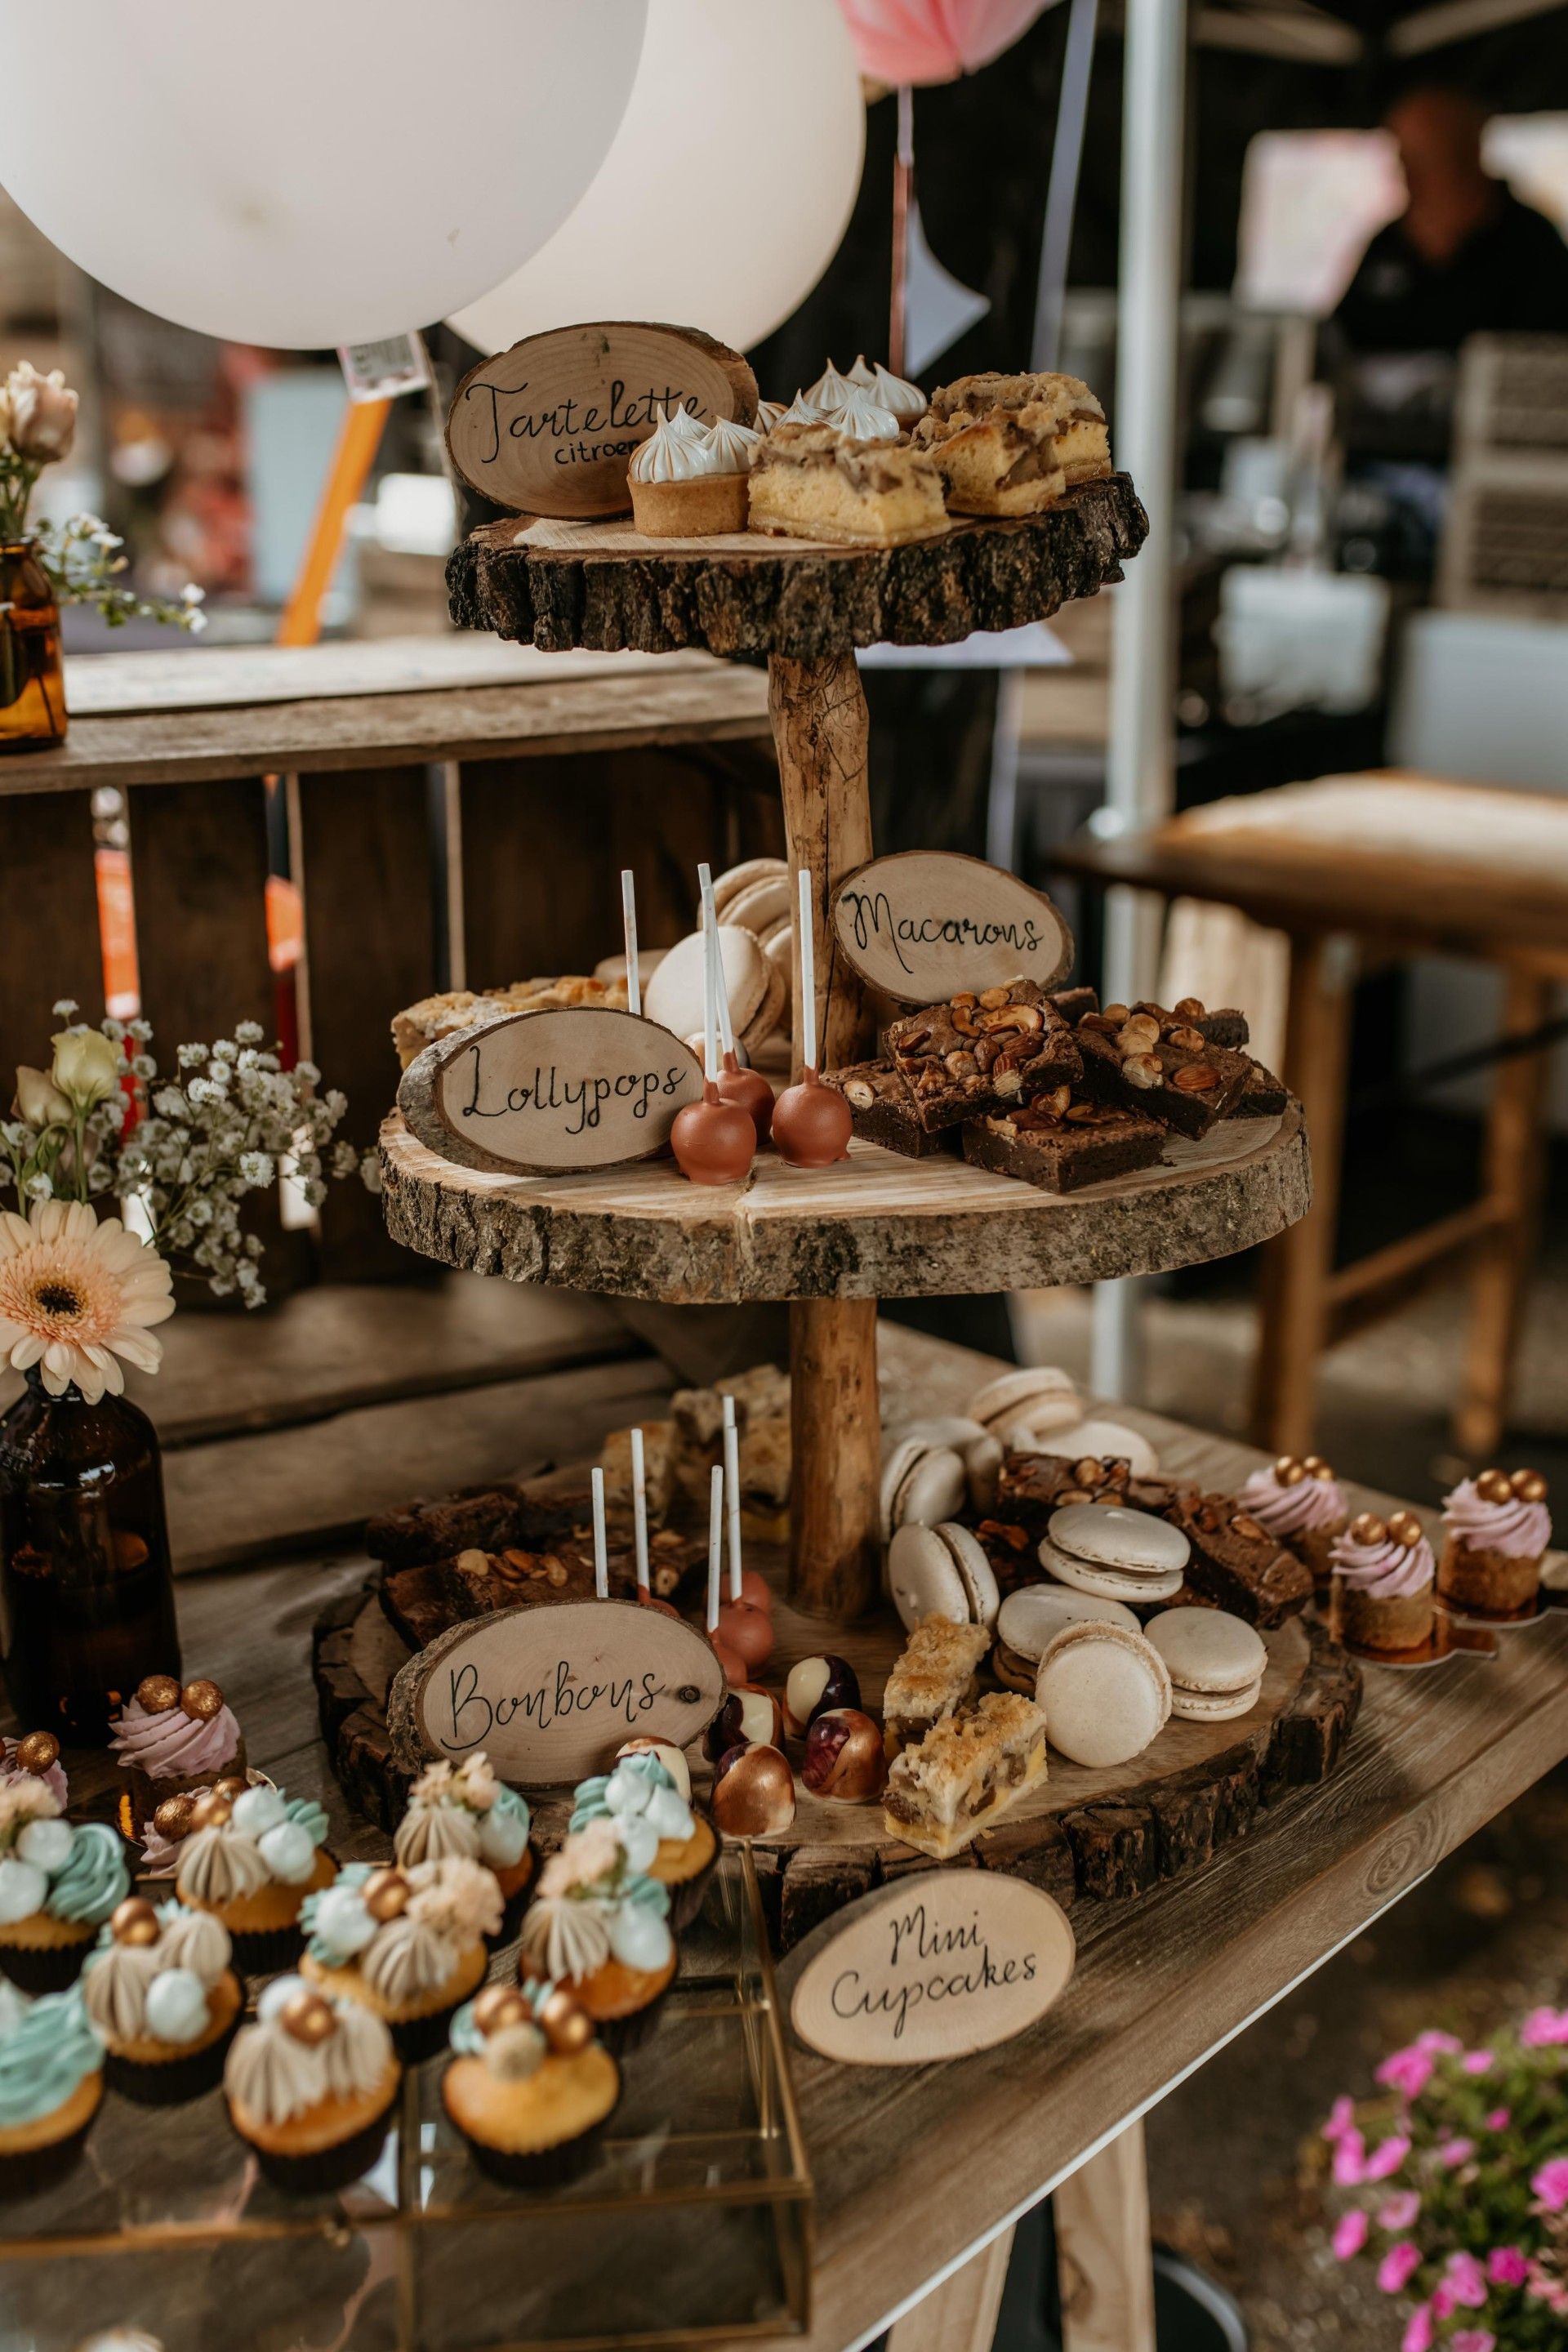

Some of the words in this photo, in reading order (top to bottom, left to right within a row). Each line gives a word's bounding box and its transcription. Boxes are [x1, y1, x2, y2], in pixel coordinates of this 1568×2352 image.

[465, 379, 707, 464] Tartelette
[841, 892, 1045, 974] Macarons
[461, 1045, 688, 1135] Lollypops
[439, 1660, 666, 1751] Bonbons
[889, 1904, 984, 1967] Mini
[831, 1944, 1037, 2039] Cupcakes
